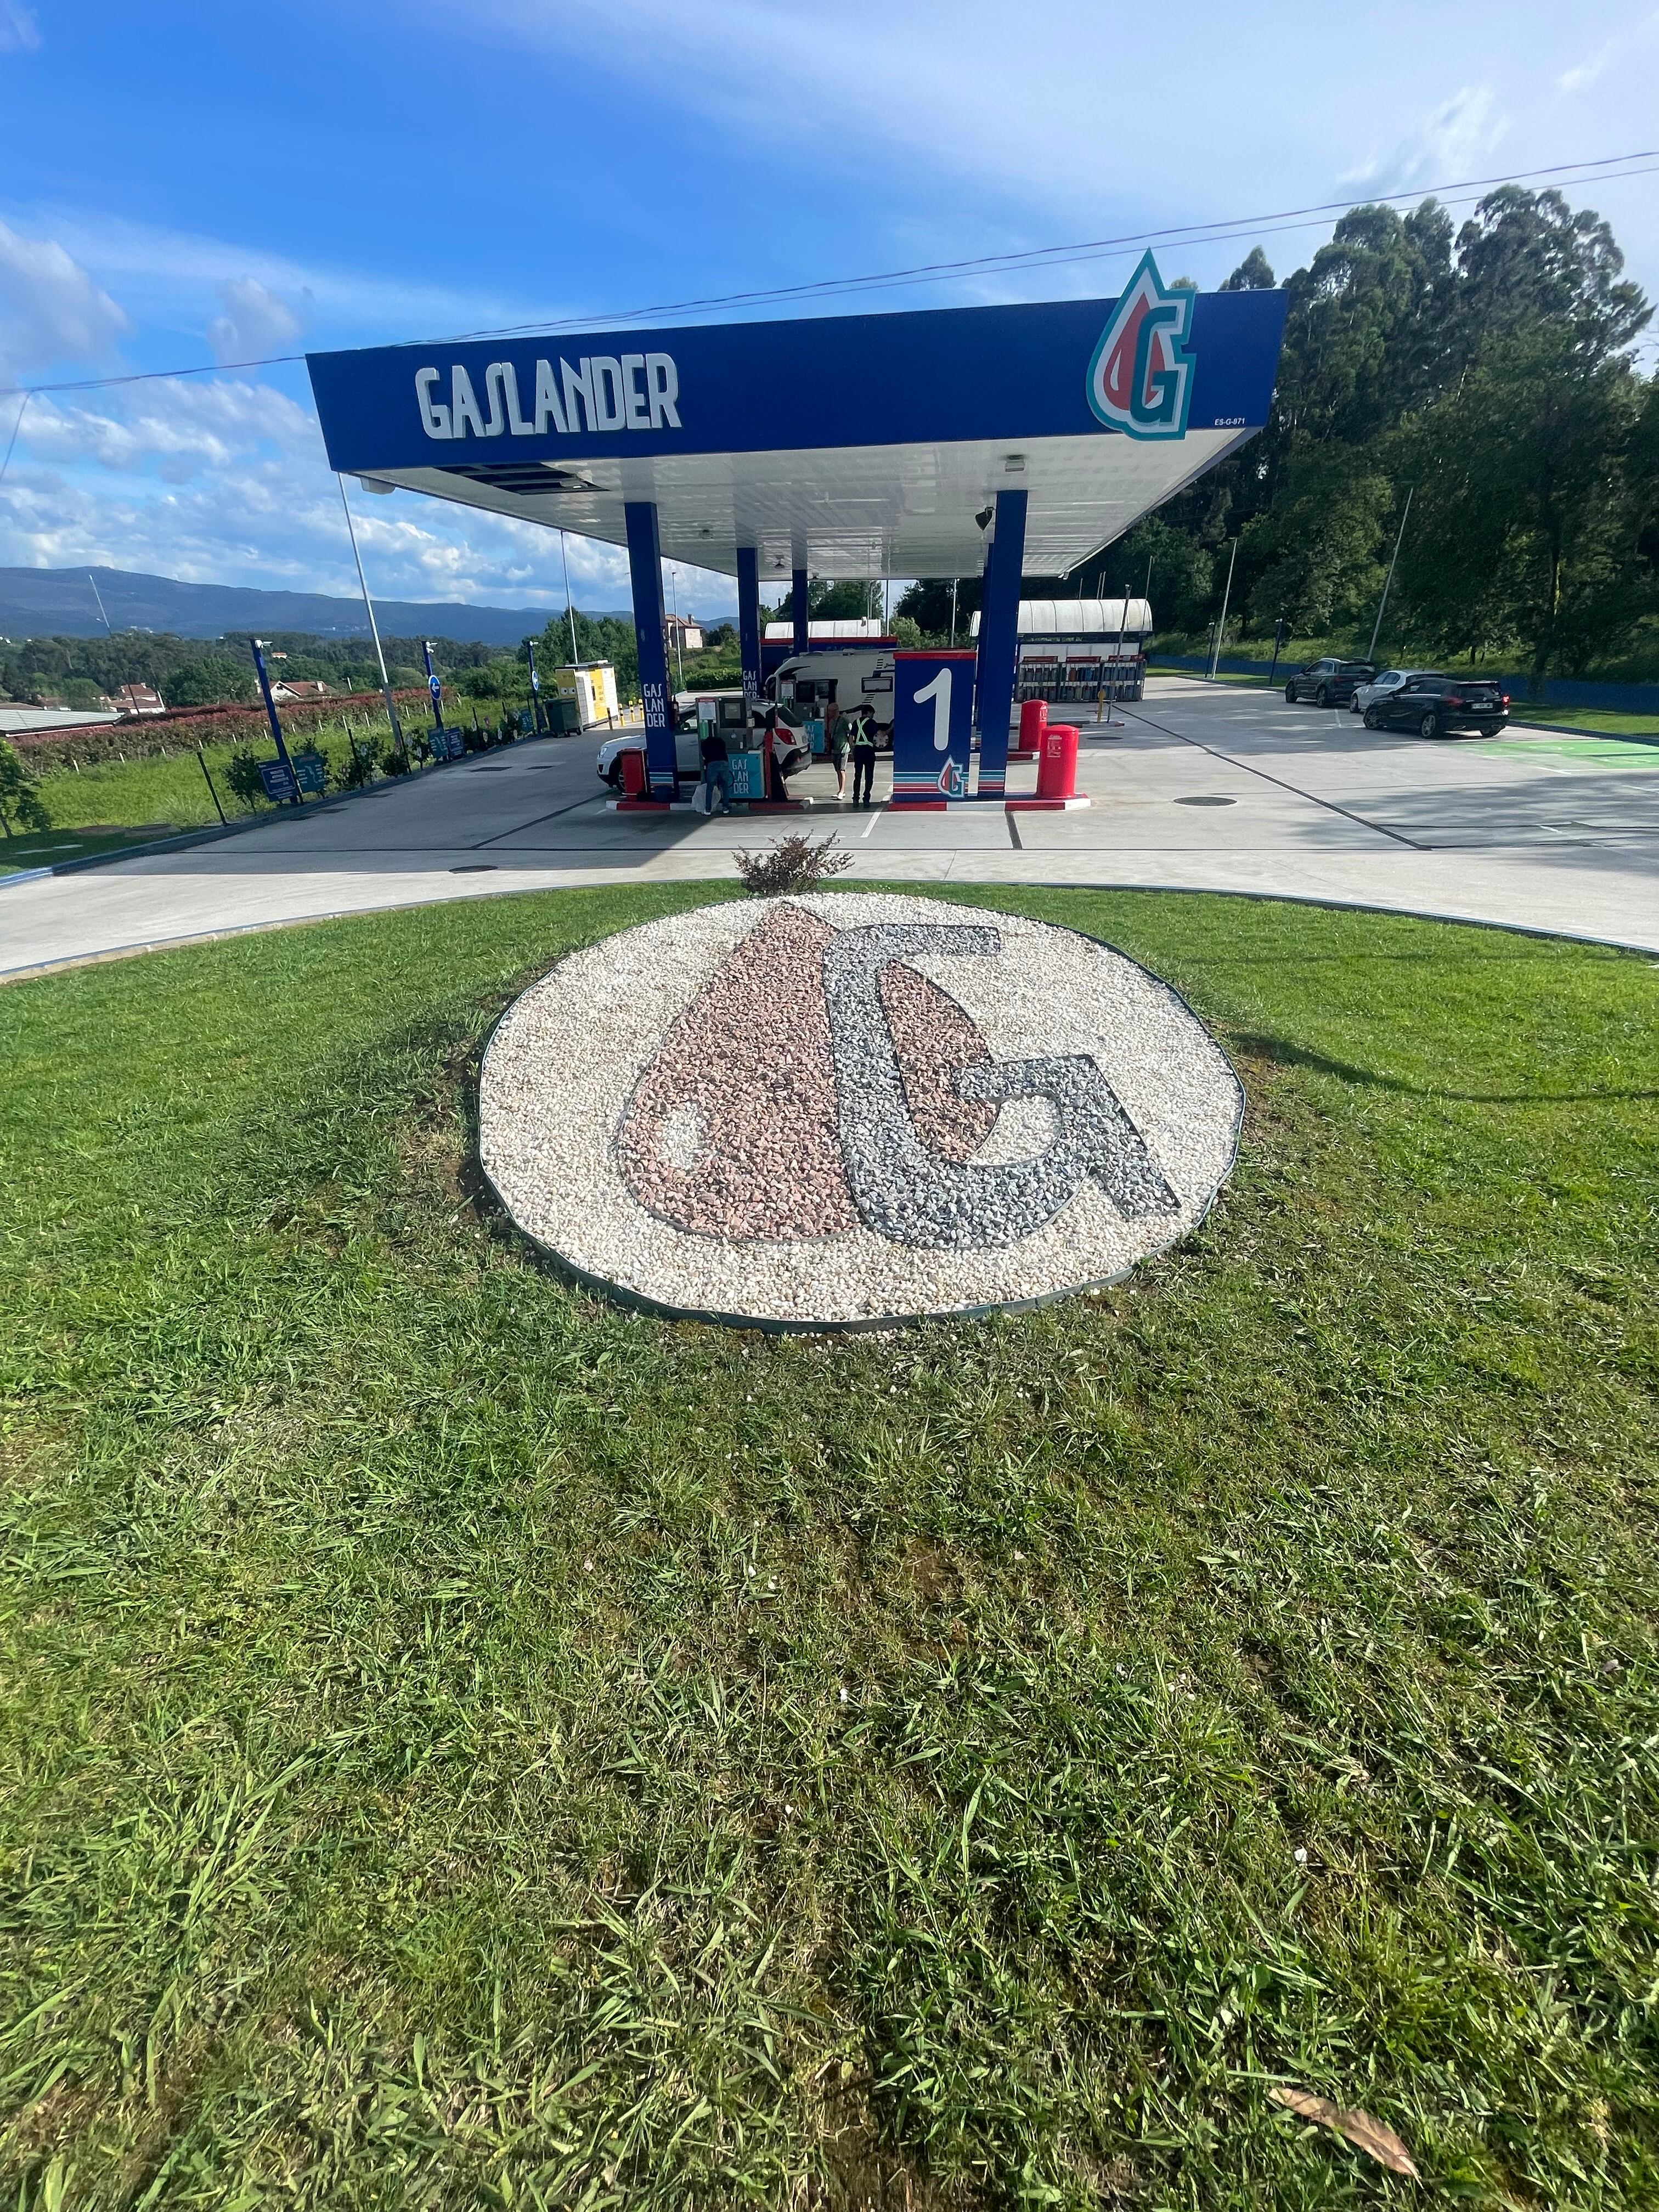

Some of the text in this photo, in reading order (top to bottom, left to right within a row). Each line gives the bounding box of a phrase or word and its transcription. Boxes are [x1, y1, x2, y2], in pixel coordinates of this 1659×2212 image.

[415, 353, 682, 439] GASLANDER
[743, 670, 757, 680] GAS
[643, 684, 662, 697] GAS
[743, 681, 757, 691] LAN
[645, 698, 665, 712] LAN
[913, 668, 952, 751] 1
[646, 713, 665, 727] DER
[732, 759, 747, 770] GAS
[733, 782, 749, 794] DER
